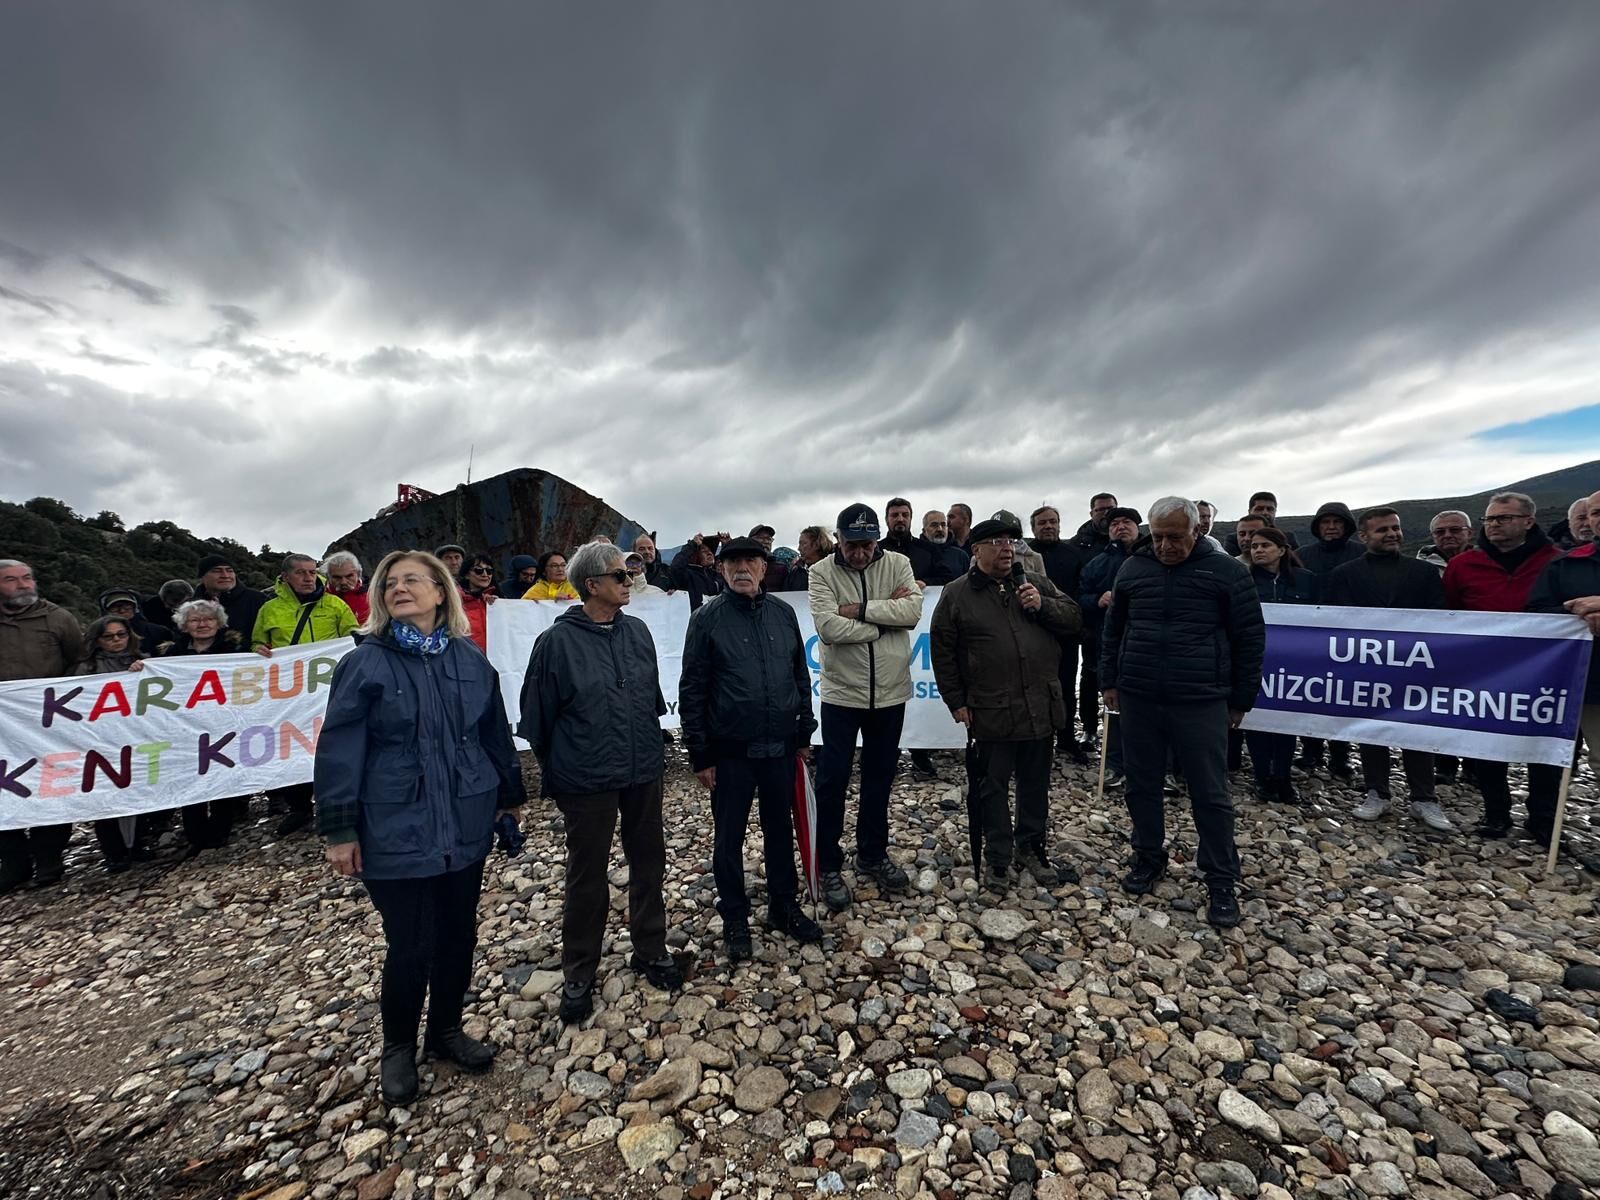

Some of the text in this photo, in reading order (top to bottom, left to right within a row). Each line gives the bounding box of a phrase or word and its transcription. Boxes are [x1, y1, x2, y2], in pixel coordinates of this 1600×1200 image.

[1329, 637, 1434, 668] URLA
[1258, 667, 1567, 724] NİZCİLER DERNEĞİ
[0, 741, 172, 799] KENT
